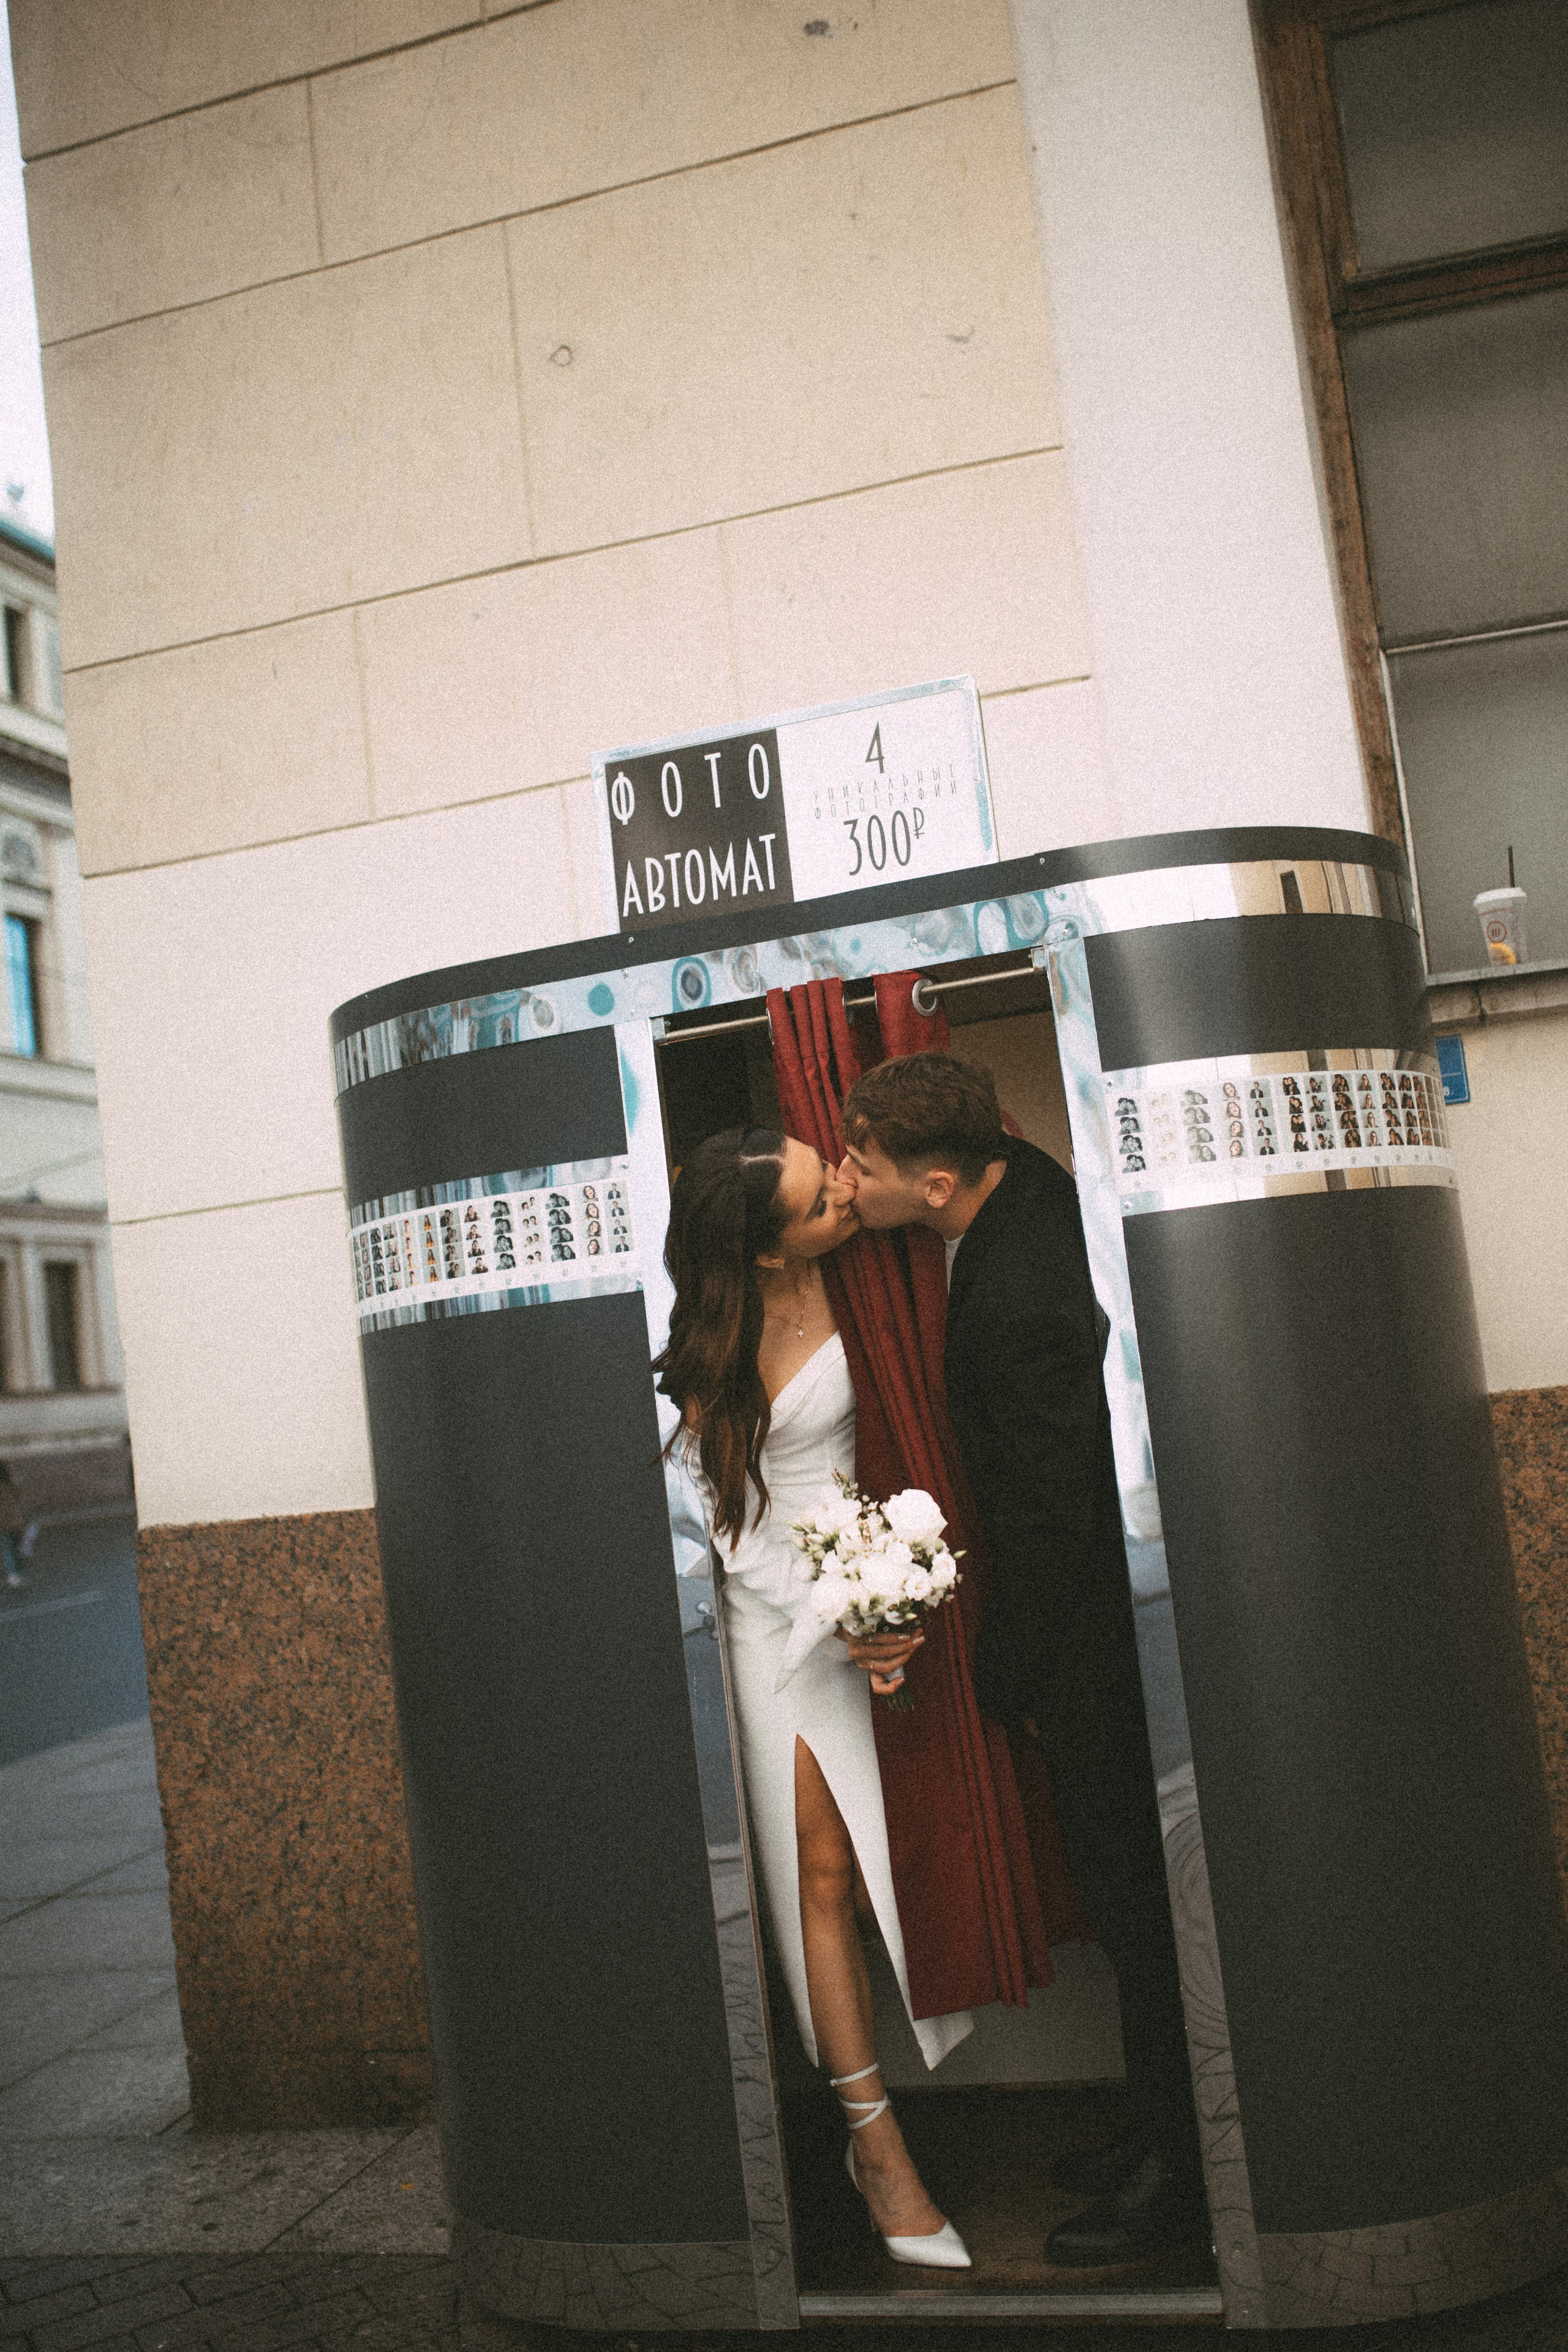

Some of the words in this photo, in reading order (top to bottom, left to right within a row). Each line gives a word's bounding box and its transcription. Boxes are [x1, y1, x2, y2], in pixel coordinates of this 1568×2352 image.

[865, 720, 885, 774] 4
[612, 743, 770, 826] ФОТО
[813, 764, 955, 804] УНИКАЛЬНЫЕ
[815, 780, 957, 820] ФОТОГРАФИИ
[623, 833, 776, 917] АВТОМАТ
